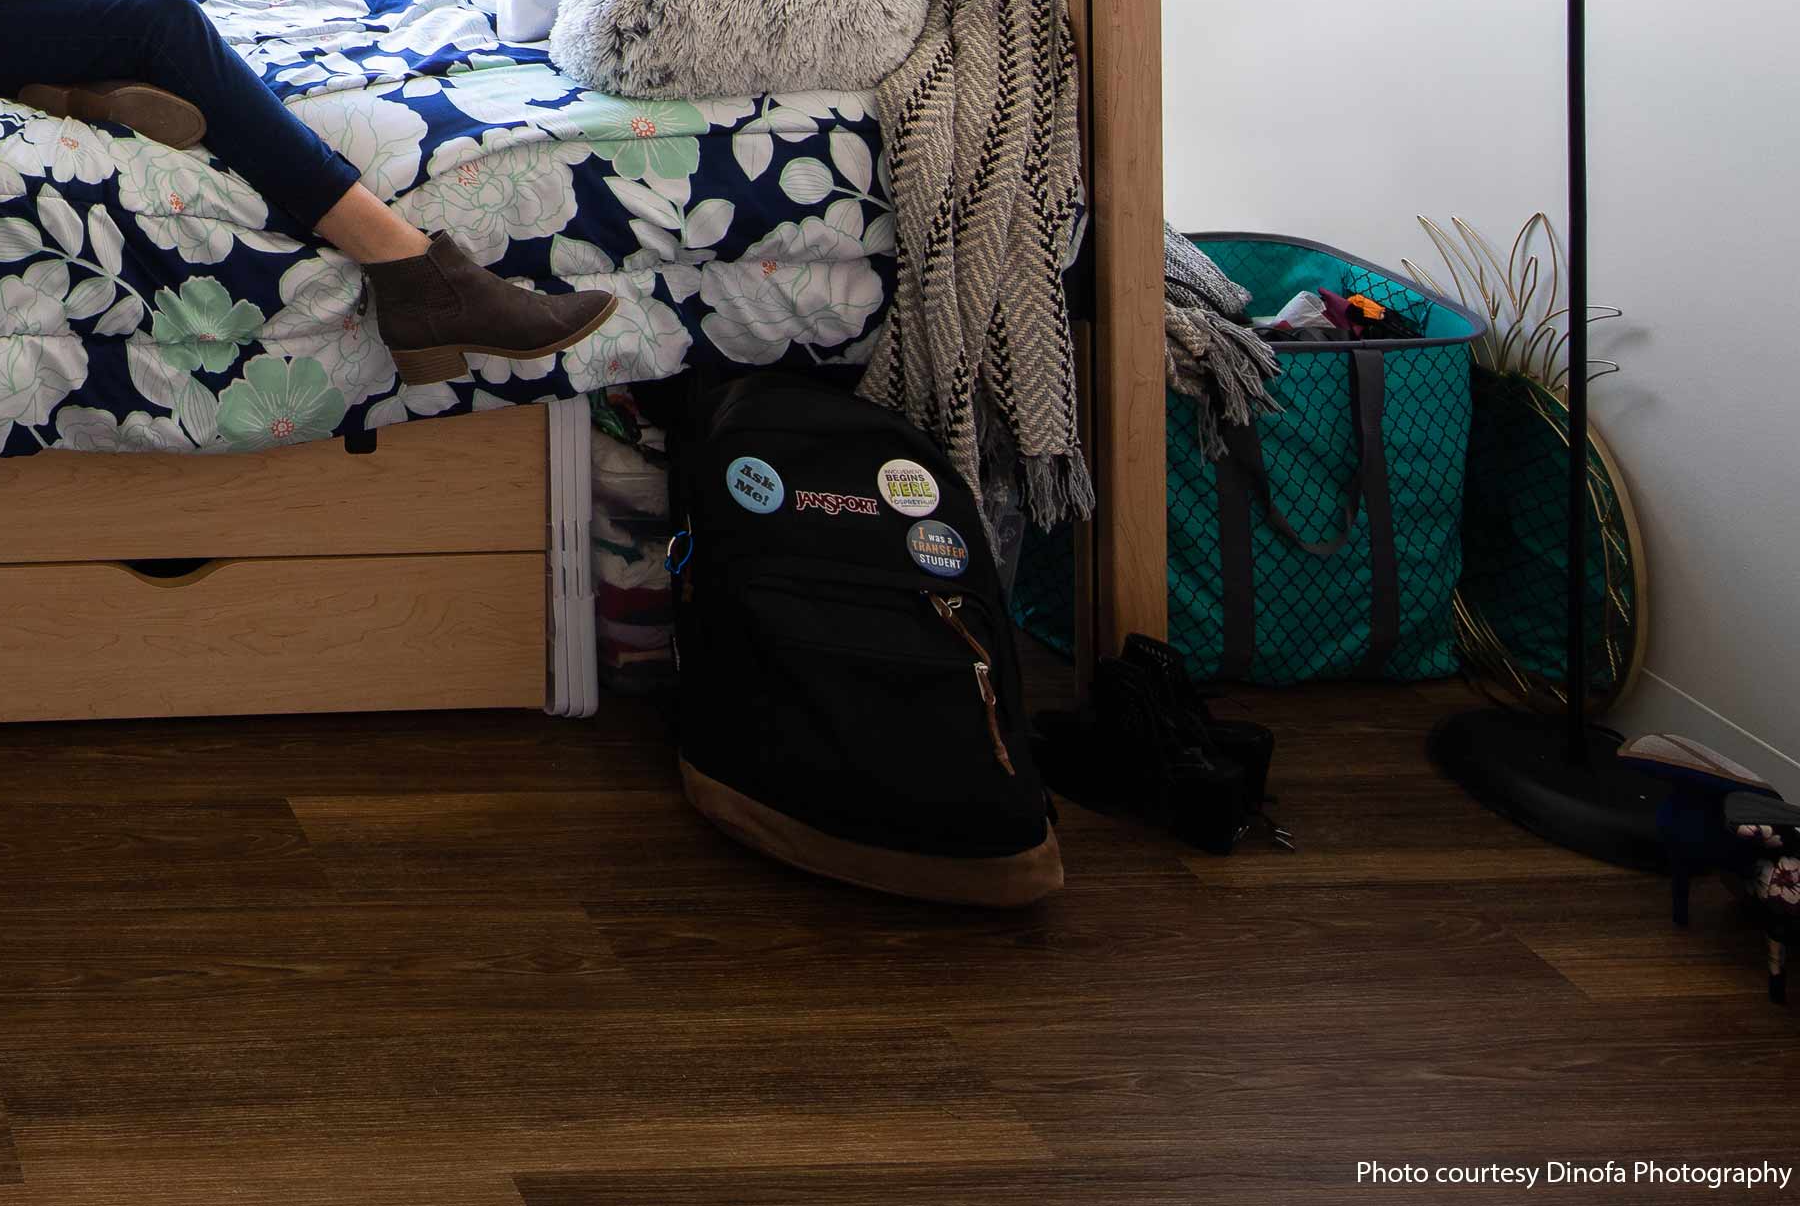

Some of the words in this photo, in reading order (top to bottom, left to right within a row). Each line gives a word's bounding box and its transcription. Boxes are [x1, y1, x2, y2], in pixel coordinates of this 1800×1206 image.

[739, 464, 776, 492] Ask
[885, 474, 926, 482] BEGINS
[734, 478, 770, 506] Me!
[918, 527, 925, 540] I
[928, 534, 945, 543] was
[947, 536, 953, 545] a
[911, 539, 966, 559] TRANSFER
[919, 553, 961, 570] STUDENT
